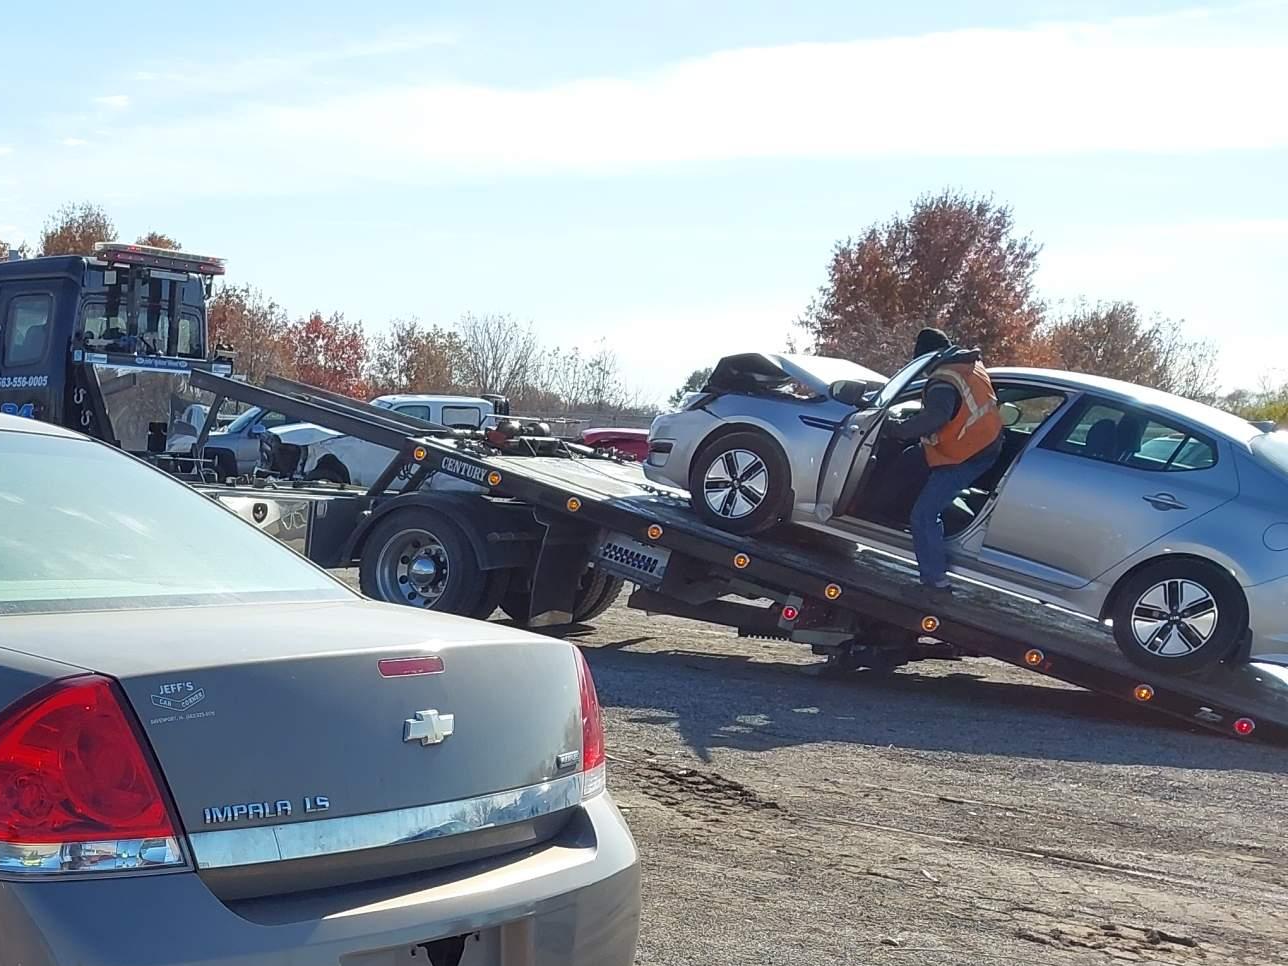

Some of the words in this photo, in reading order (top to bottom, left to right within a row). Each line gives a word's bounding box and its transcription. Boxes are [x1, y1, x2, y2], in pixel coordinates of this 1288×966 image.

[441, 456, 488, 482] CENTURY
[159, 681, 194, 695] JEFF'S
[159, 698, 172, 707] CAR
[181, 691, 203, 708] CORNER
[204, 800, 292, 824] IMPALA
[304, 796, 330, 813] LS
